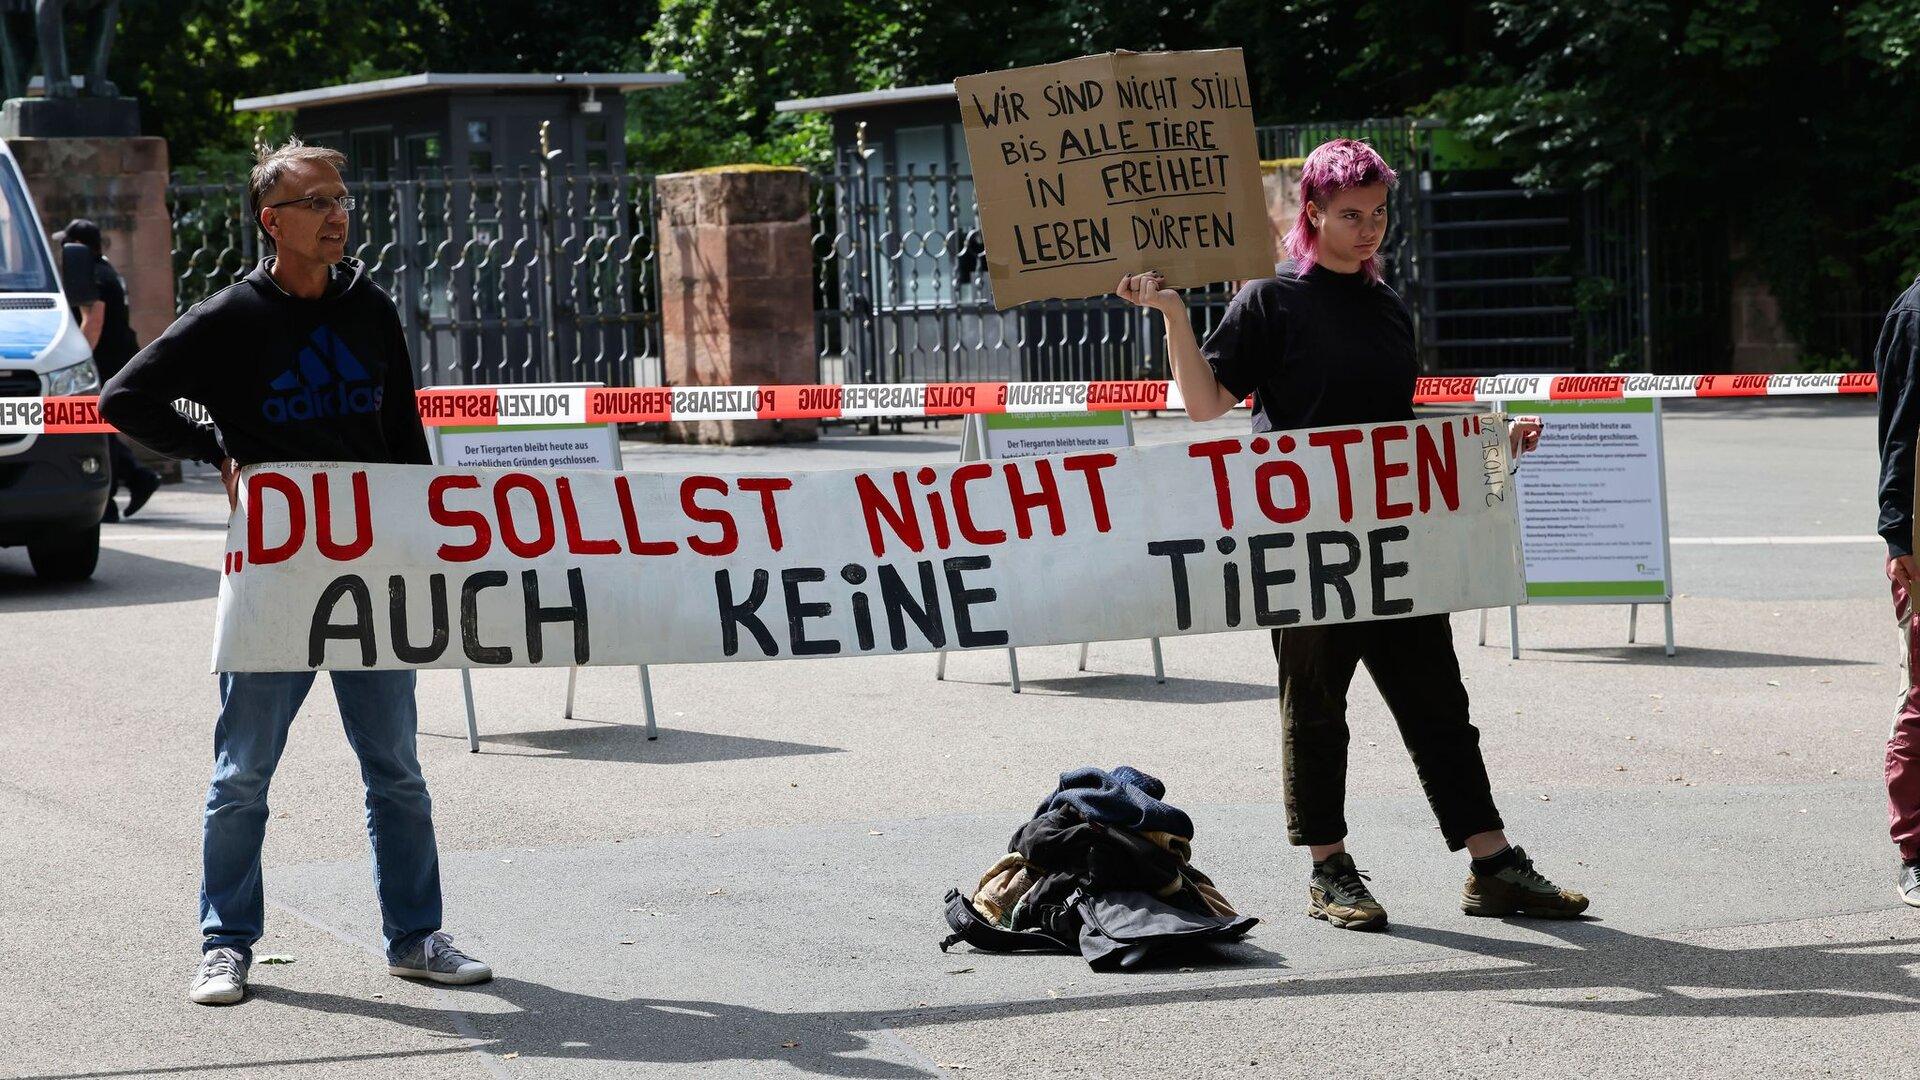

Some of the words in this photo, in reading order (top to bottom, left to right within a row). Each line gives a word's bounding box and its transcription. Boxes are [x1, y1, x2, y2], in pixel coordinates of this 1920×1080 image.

[1059, 119, 1139, 160] ALLE
[1013, 216, 1112, 267] LEBEN
[1131, 207, 1236, 252] DÜRFEN
[262, 381, 384, 422] adidas
[1007, 439, 1020, 449] Der
[1020, 438, 1056, 450] Tiergarten
[1056, 438, 1076, 448] bleibt
[1077, 437, 1097, 446] heute
[1098, 438, 1109, 446] aus
[1545, 422, 1579, 432] Tiergarten
[465, 445, 479, 455] Der
[480, 443, 523, 456] Tiergarten
[524, 442, 549, 452] bleibt
[549, 441, 573, 452] heute
[575, 442, 588, 450] aus
[513, 455, 548, 467] Gründen
[549, 455, 600, 468] geschlossen.
[428, 473, 793, 562] SOLLST
[307, 566, 590, 668] AUCH
